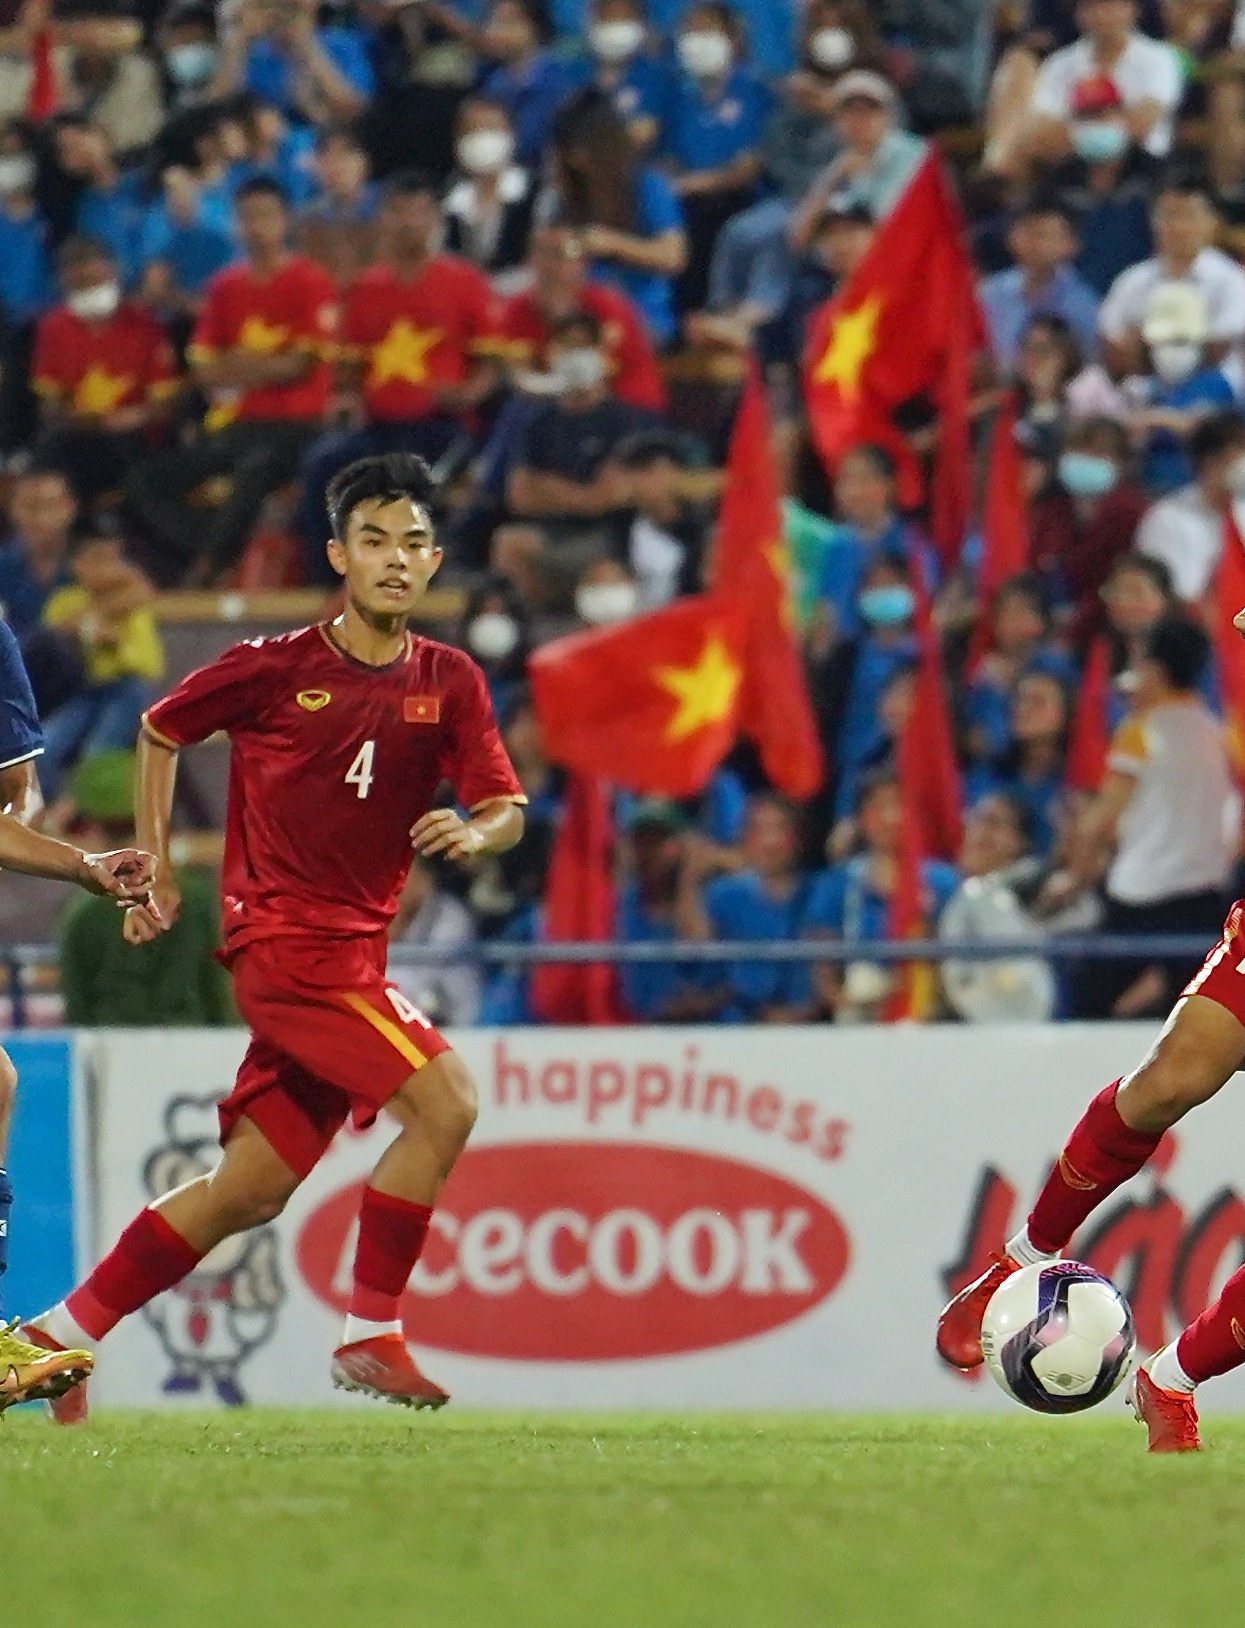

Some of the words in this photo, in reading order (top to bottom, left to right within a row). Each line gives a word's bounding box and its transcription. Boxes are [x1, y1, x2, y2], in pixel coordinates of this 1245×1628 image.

[344, 740, 375, 799] 4
[385, 987, 432, 1030] 4
[493, 1038, 853, 1161] happiness
